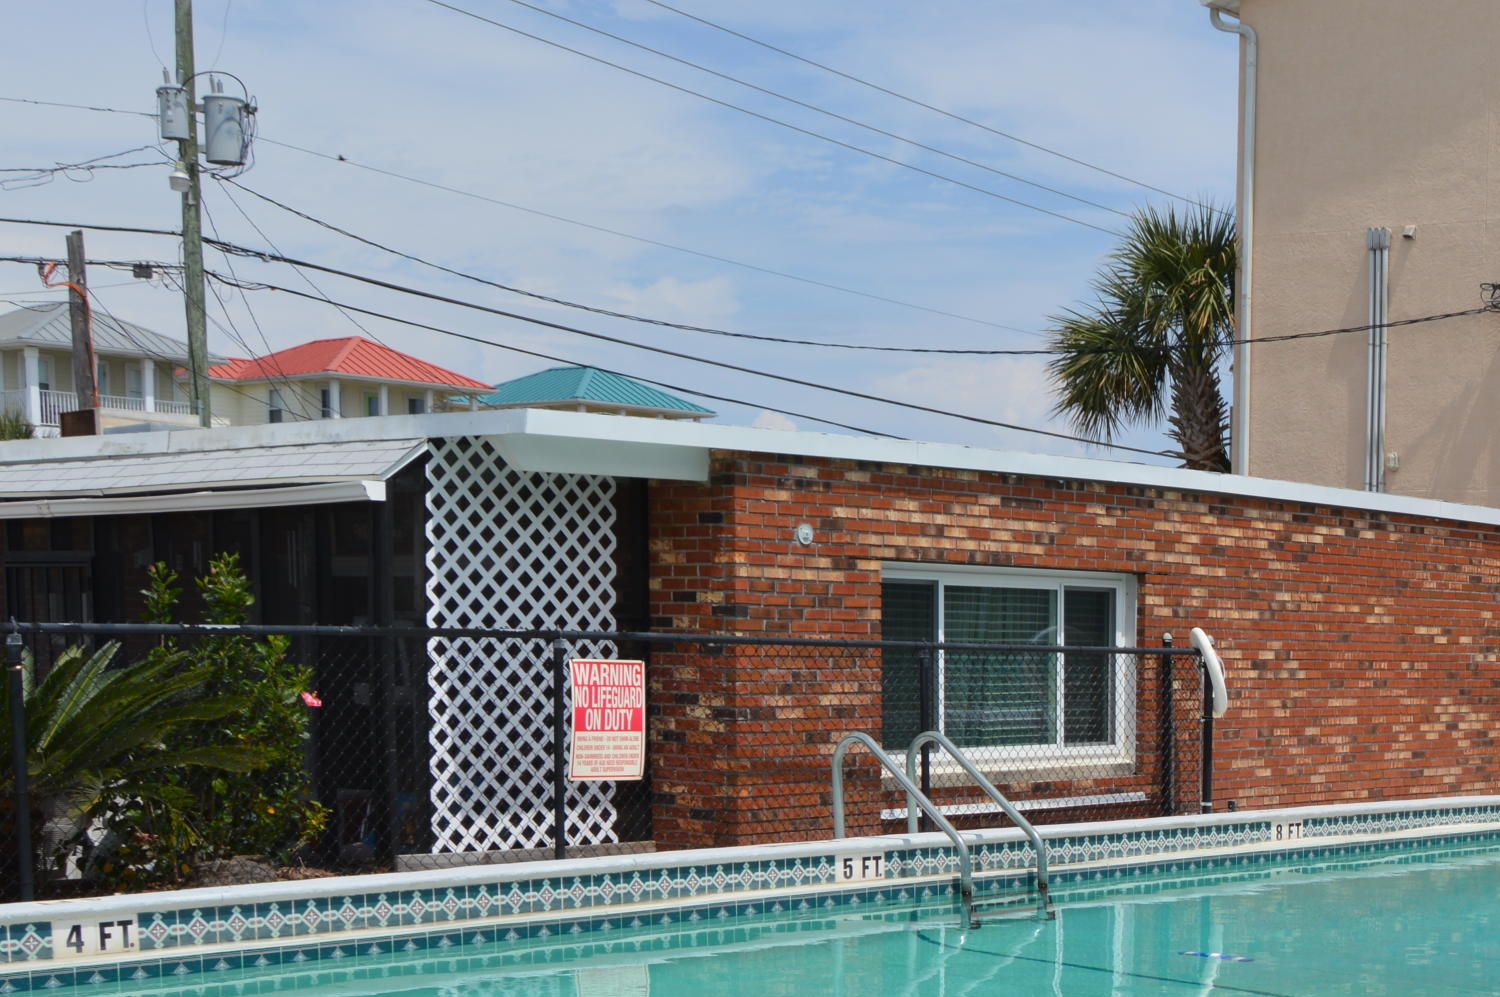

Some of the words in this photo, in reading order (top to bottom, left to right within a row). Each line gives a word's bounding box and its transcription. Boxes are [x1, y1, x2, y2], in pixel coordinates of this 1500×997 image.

[573, 663, 642, 687] WARNING
[575, 686, 589, 708] NO
[592, 686, 642, 708] LIFEGUARD
[585, 708, 602, 731] ON
[604, 708, 634, 731] DUTY
[1276, 824, 1283, 841] 8
[843, 857, 853, 879] 5
[862, 855, 882, 879] FT.
[66, 924, 84, 953] 4
[99, 920, 135, 950] FT.
